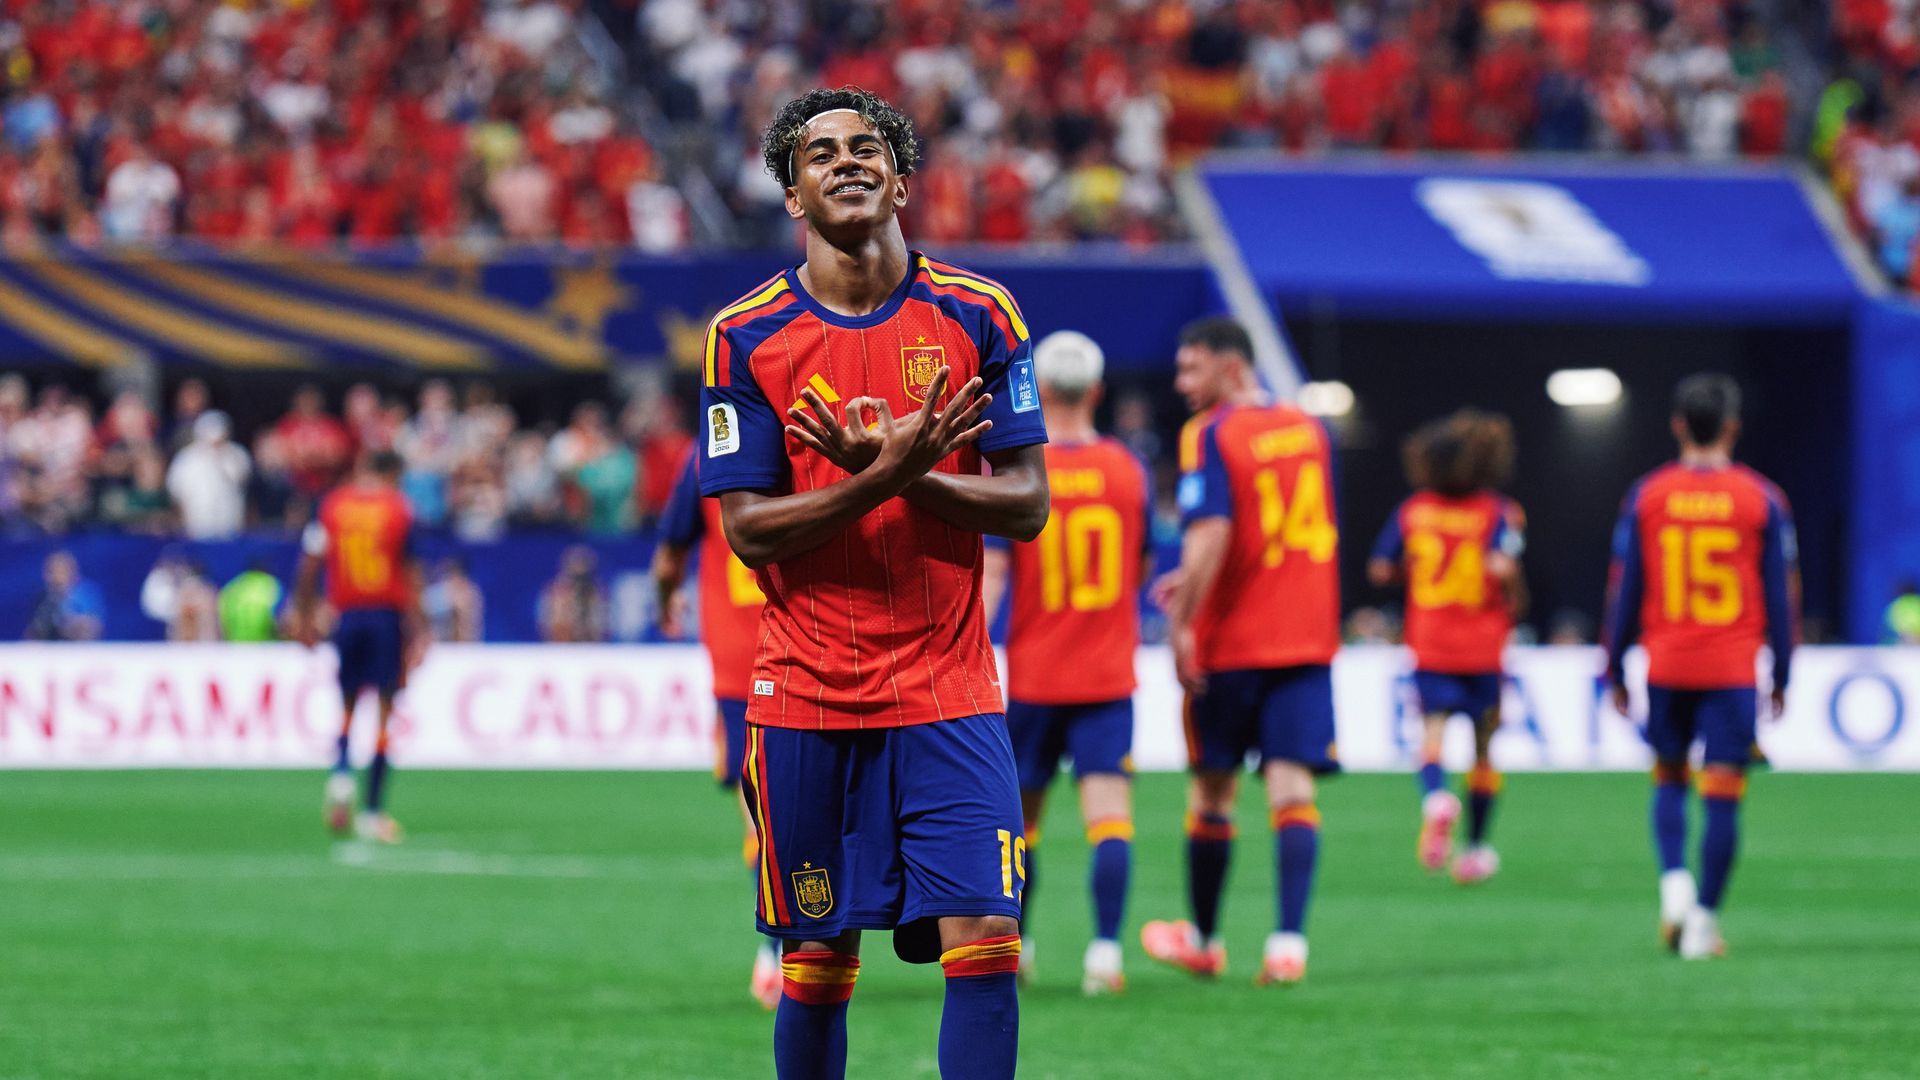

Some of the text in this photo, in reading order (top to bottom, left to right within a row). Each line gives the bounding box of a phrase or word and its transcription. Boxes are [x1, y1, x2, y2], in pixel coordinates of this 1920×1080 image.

[1040, 504, 1122, 613] 10
[1255, 461, 1338, 569] 14
[1660, 526, 1741, 625] 15
